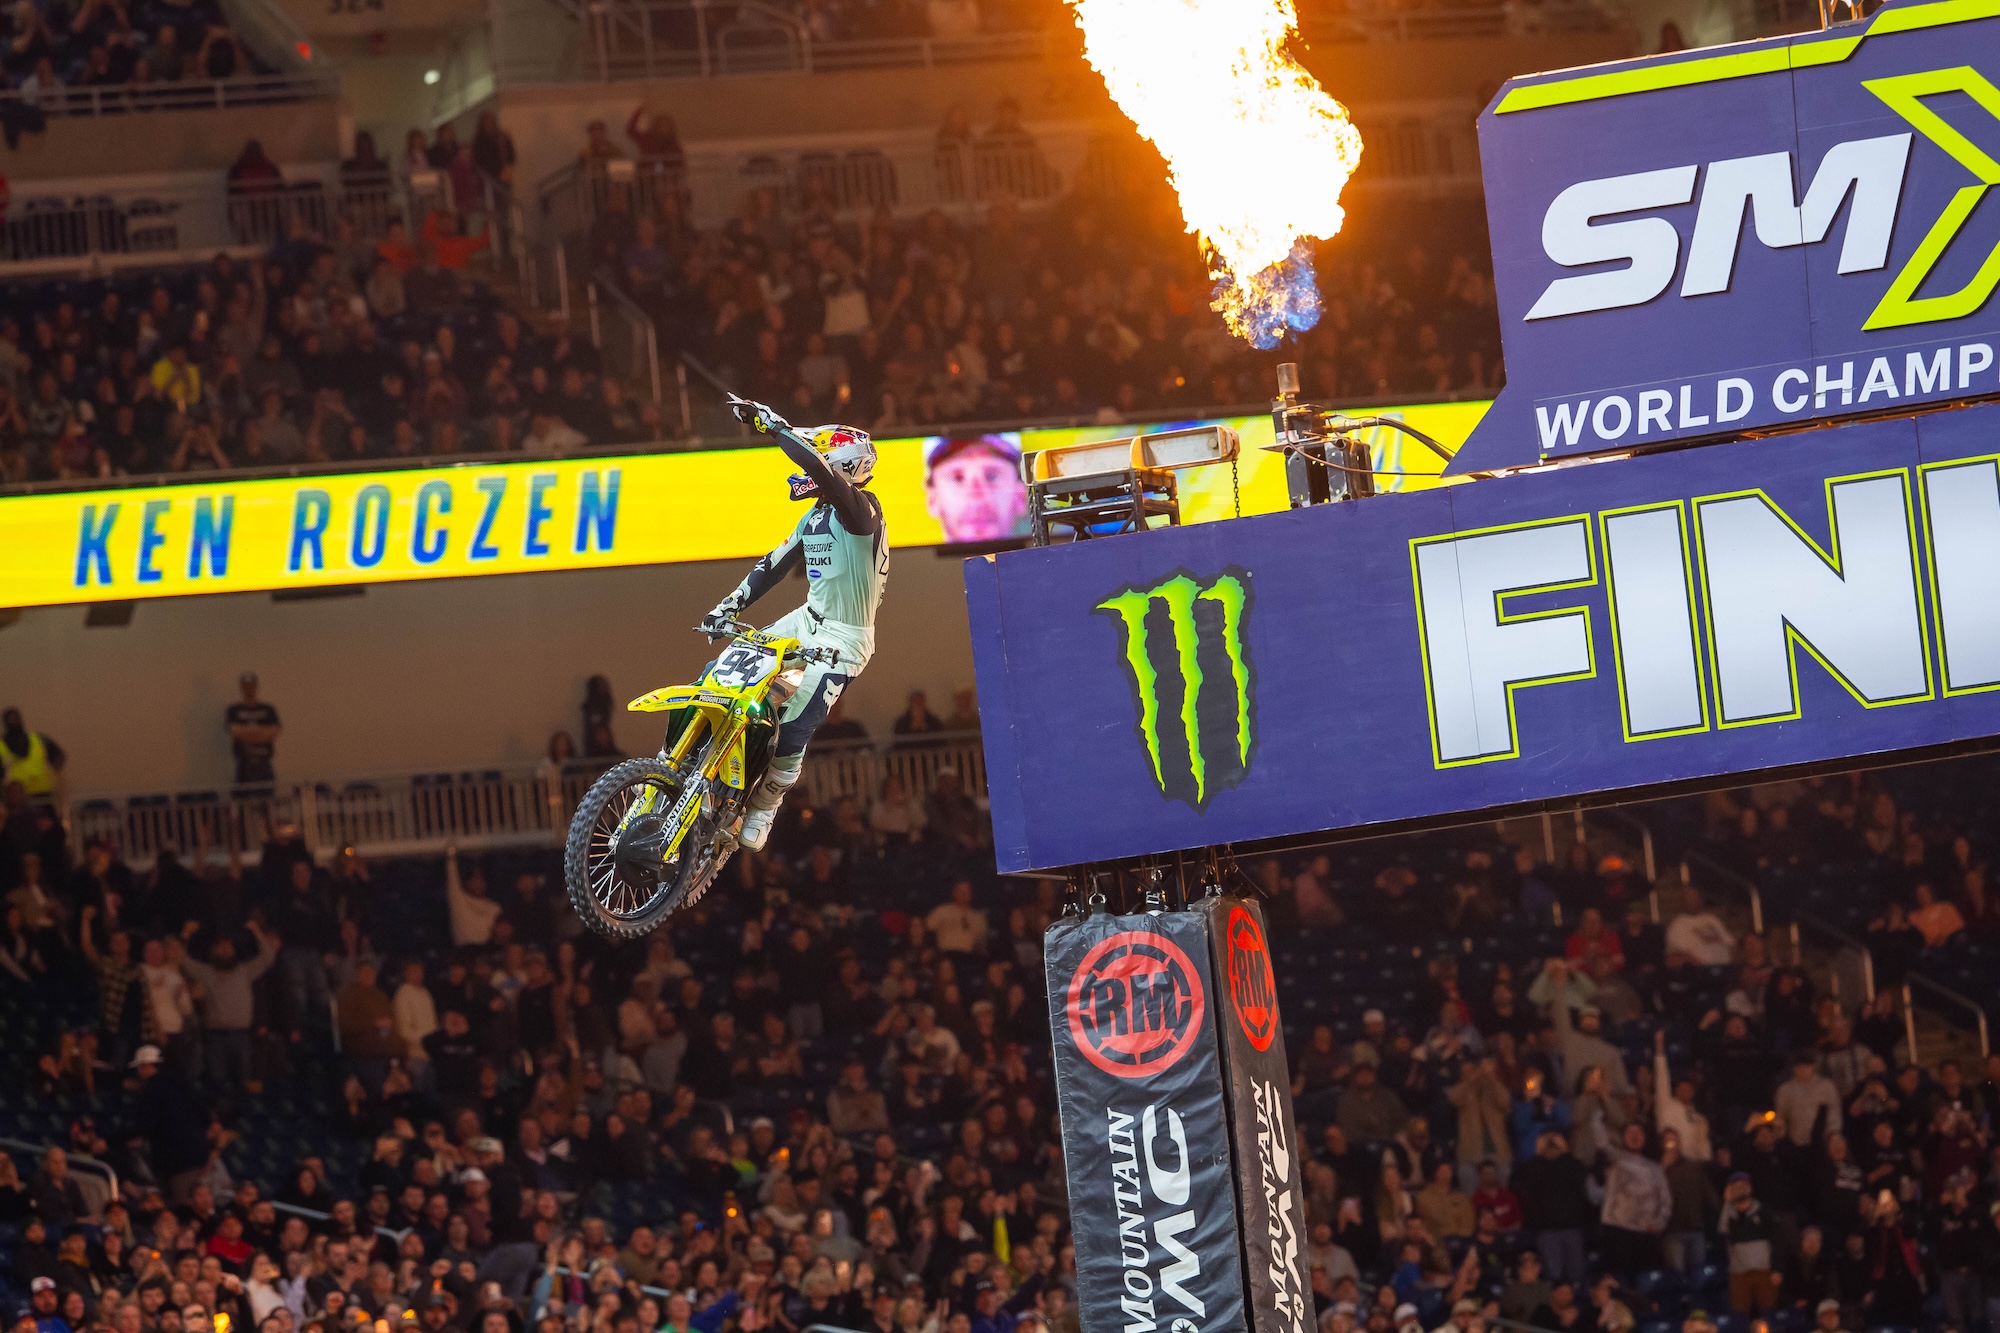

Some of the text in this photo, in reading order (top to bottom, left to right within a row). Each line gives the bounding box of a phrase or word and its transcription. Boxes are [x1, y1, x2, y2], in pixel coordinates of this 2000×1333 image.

[1536, 377, 1754, 448] WORLD
[793, 477, 816, 496] Red
[74, 469, 622, 588] KEN ROCZEN
[1409, 454, 2000, 769] FINI
[714, 650, 765, 682] 94
[662, 791, 691, 835] DUNLOP
[1094, 971, 1178, 1039] RM
[1250, 1075, 1292, 1324] MOUNTAIN
